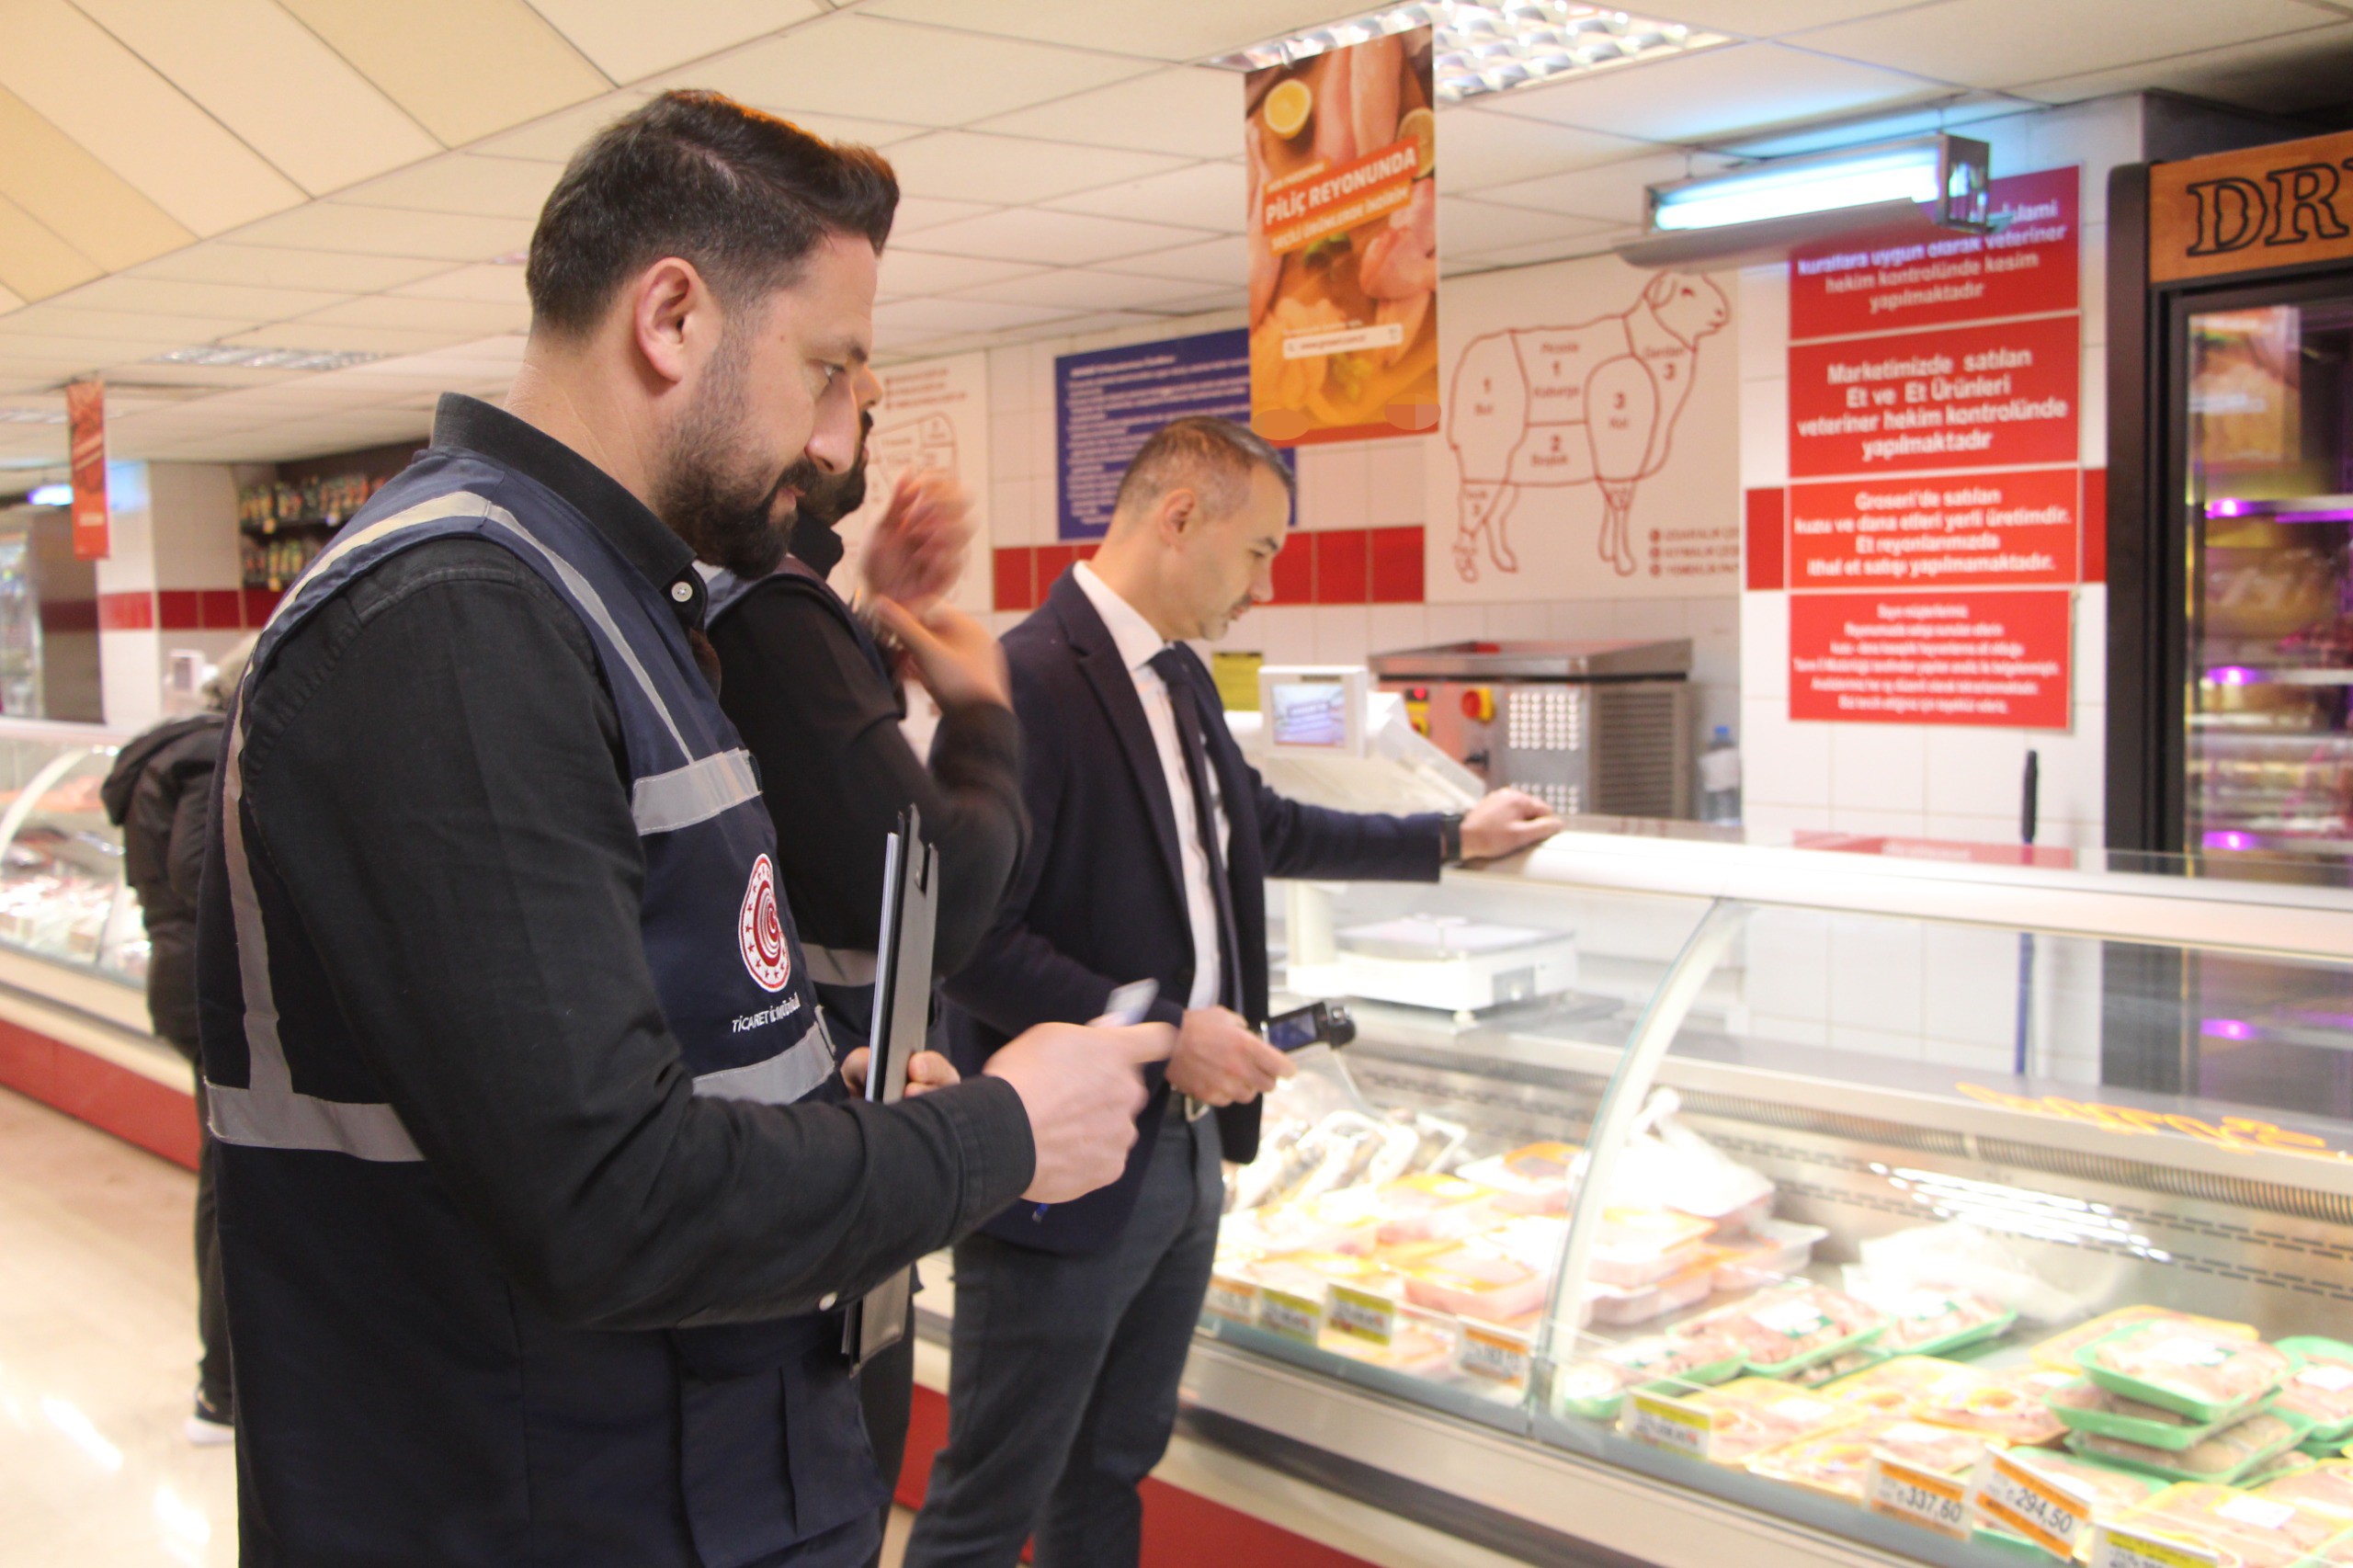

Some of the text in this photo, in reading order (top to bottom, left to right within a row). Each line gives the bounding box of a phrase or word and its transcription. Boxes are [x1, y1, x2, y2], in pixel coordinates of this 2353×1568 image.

[1265, 189, 1306, 225] PİLİÇ
[1309, 147, 1416, 208] REYONUNDA
[2186, 157, 2353, 257] DR
[1984, 225, 2067, 250] veteriner
[1825, 252, 2040, 293] hekim kontrolünde kesim
[1827, 347, 2032, 385] Marketimizde satılan
[1846, 373, 2011, 409] Et ve Et Ürünleri
[1797, 396, 2069, 437] veteriner hekim kontrolünde
[1862, 427, 1994, 462] yapılmaktadır
[1793, 516, 1833, 535] kuzu
[1835, 517, 1855, 533] ve
[1857, 514, 1898, 533] dana
[1855, 534, 1874, 554] Et
[1844, 559, 1862, 576] et
[732, 1011, 768, 1033] TİCARET
